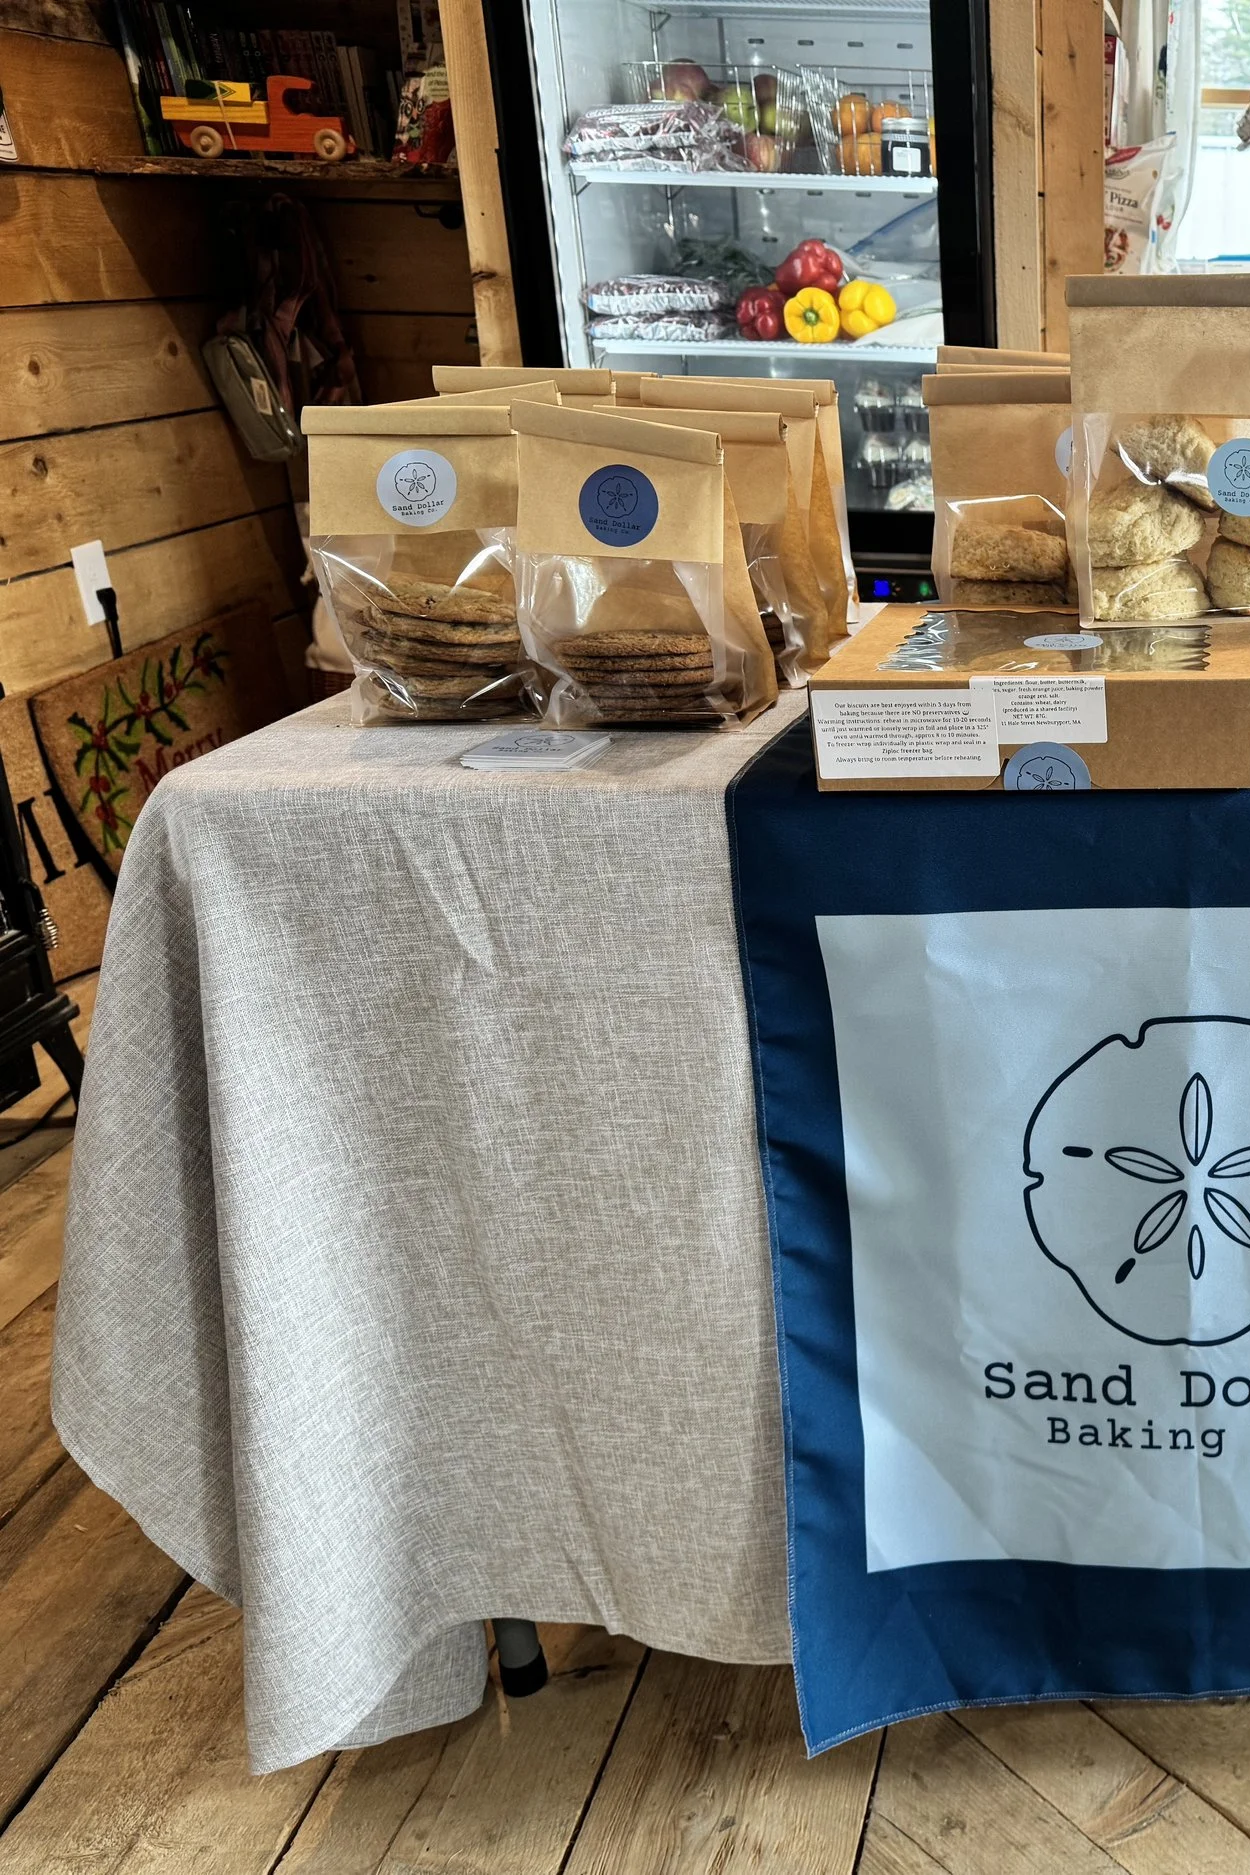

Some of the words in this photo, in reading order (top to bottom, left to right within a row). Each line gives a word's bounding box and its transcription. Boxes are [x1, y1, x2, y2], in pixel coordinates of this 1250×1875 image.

[1110, 191, 1138, 208] Pizza
[1217, 489, 1236, 497] Sand
[392, 503, 413, 512] Sand
[417, 500, 444, 510] Dollar
[588, 516, 608, 526] Sand
[612, 520, 641, 531] Dollar
[983, 1361, 1137, 1406] Sand
[1046, 1416, 1226, 1458] Baking
